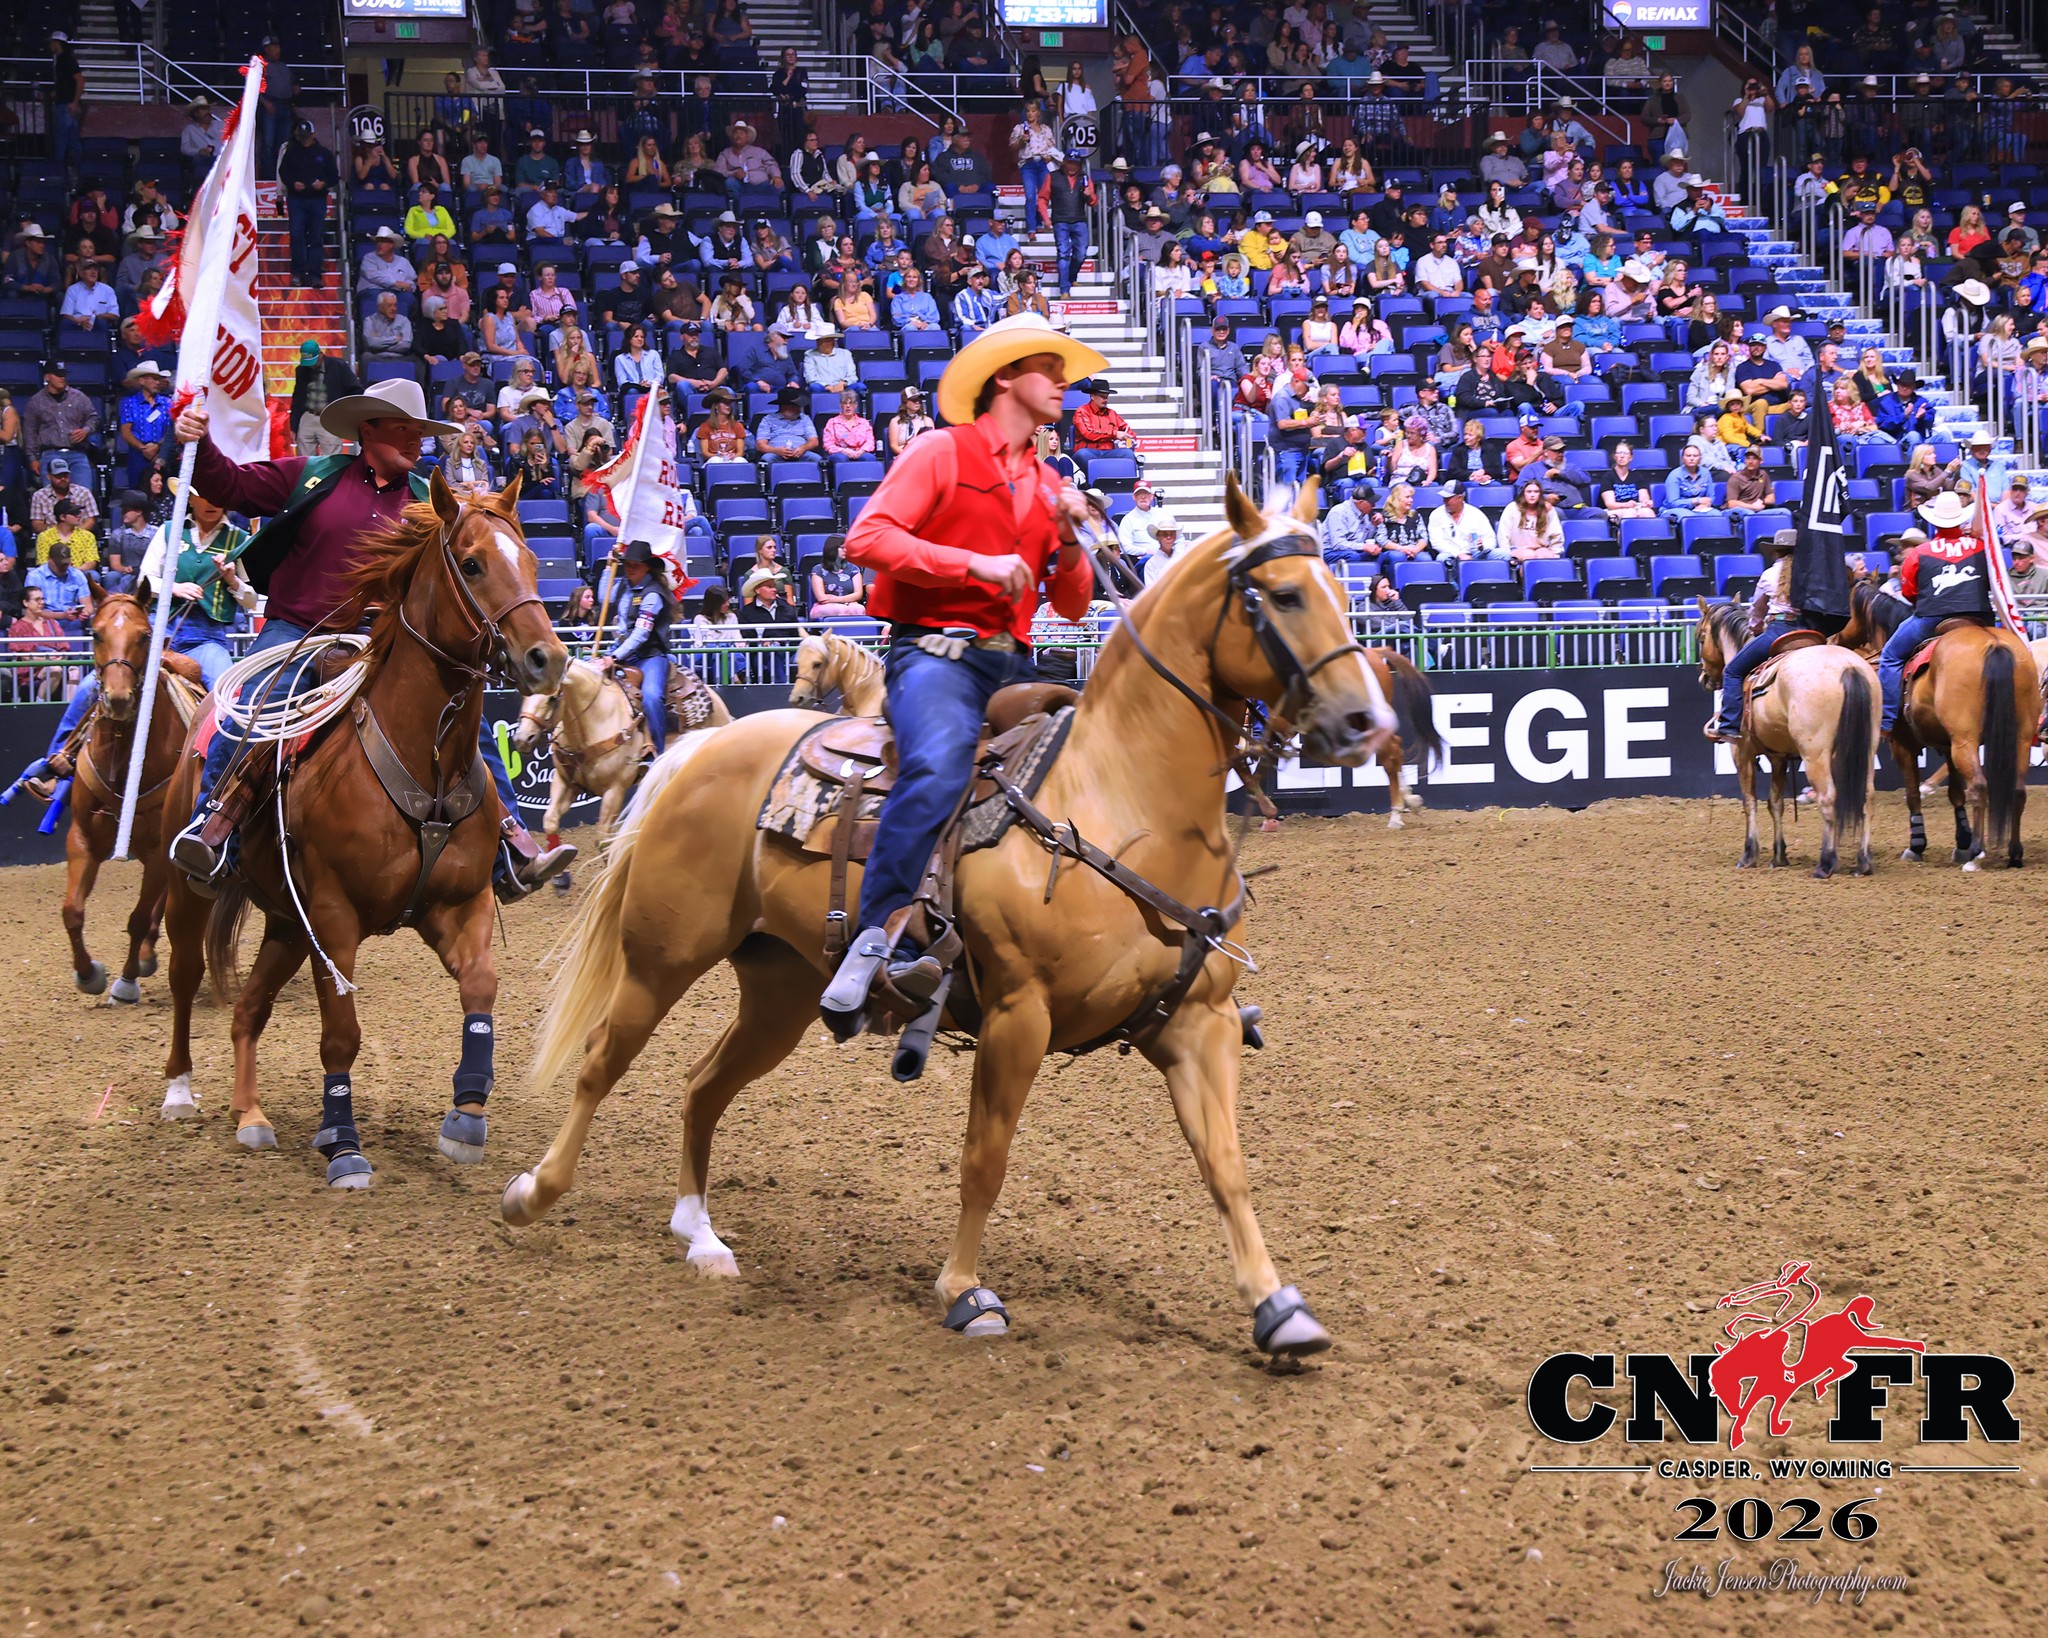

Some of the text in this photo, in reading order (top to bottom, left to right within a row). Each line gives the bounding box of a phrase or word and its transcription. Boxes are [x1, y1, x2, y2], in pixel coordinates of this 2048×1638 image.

[1636, 7, 1699, 21] RE/MAX
[352, 116, 384, 136] 106
[1929, 537, 1978, 558] UMW
